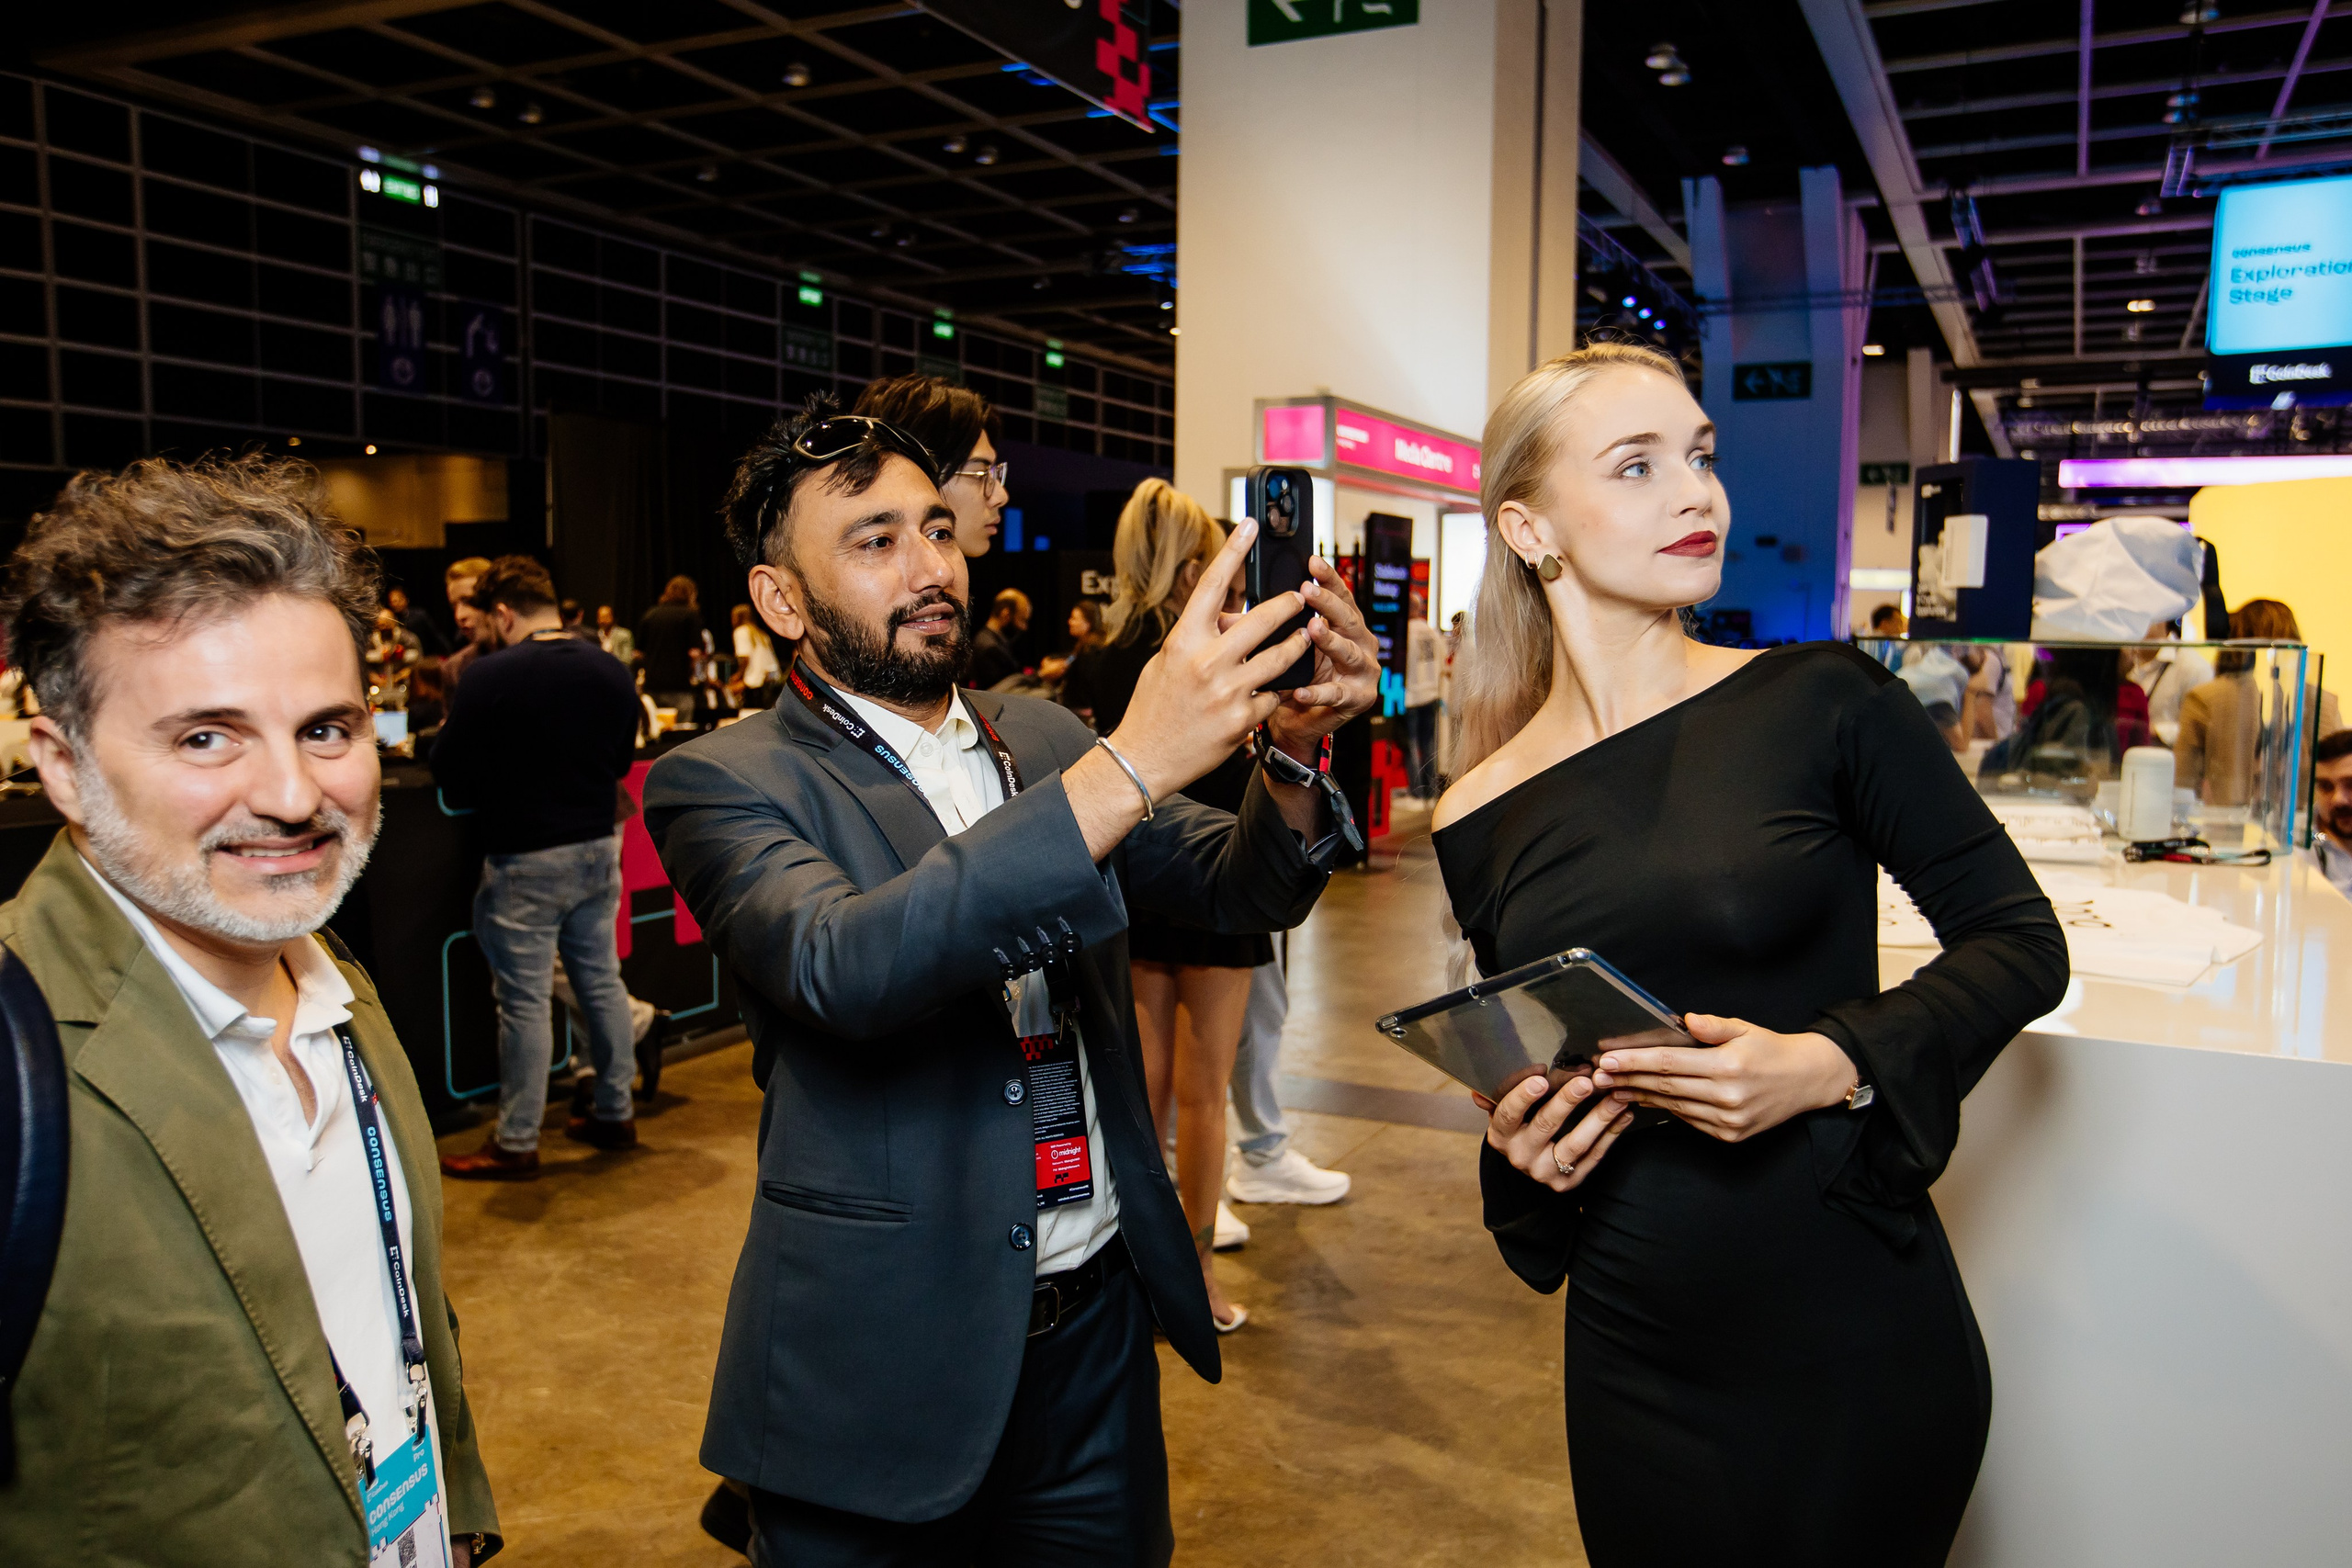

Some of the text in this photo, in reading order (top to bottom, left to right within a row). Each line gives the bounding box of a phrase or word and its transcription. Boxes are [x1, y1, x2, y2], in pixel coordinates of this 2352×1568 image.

[2229, 288, 2293, 306] Stage
[822, 704, 855, 730] CoinDesk
[1002, 760, 1019, 797] CoinDesk
[347, 1050, 368, 1103] CoinDesk
[1059, 1146, 1081, 1156] midnight
[368, 1126, 392, 1222] CONSENSUS
[393, 1261, 410, 1317] CoinDesk
[413, 1449, 425, 1462] Pro
[369, 1462, 428, 1525] CONSENSUS
[371, 1500, 405, 1538] Hong Kong
